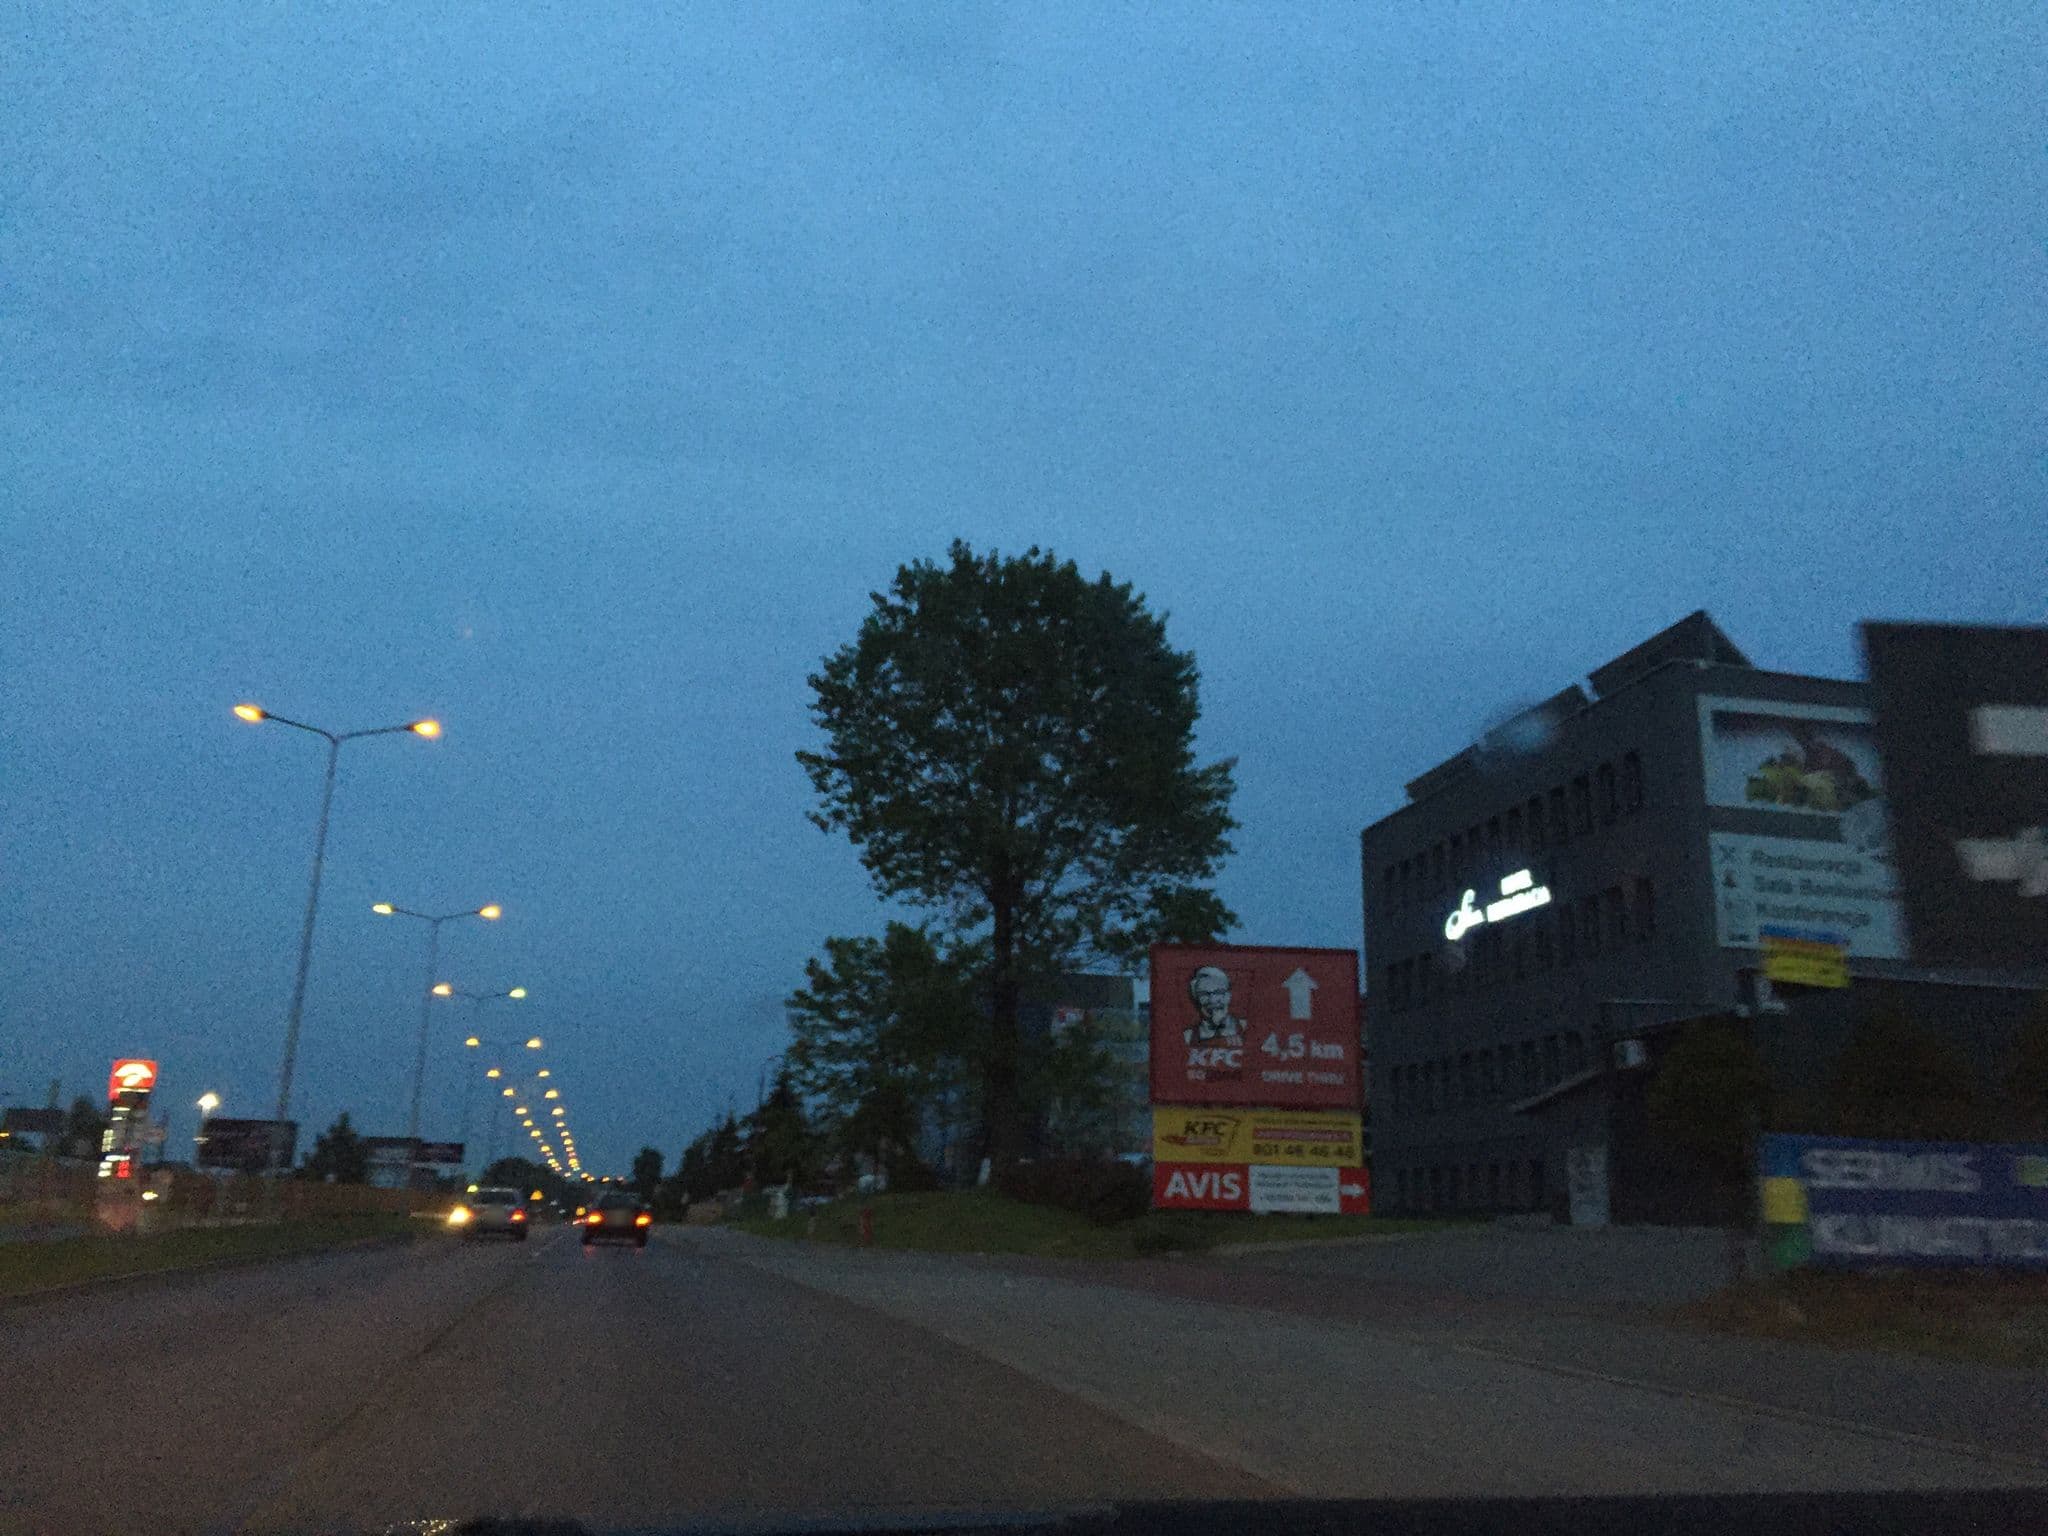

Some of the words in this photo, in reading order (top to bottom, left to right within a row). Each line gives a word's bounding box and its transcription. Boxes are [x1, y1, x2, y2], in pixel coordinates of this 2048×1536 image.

[1186, 1048, 1243, 1067] KFC
[1261, 1032, 1305, 1061] 4,5
[1310, 1040, 1345, 1059] km
[1184, 1120, 1227, 1136] KFC
[1164, 1171, 1242, 1200] AVIS
